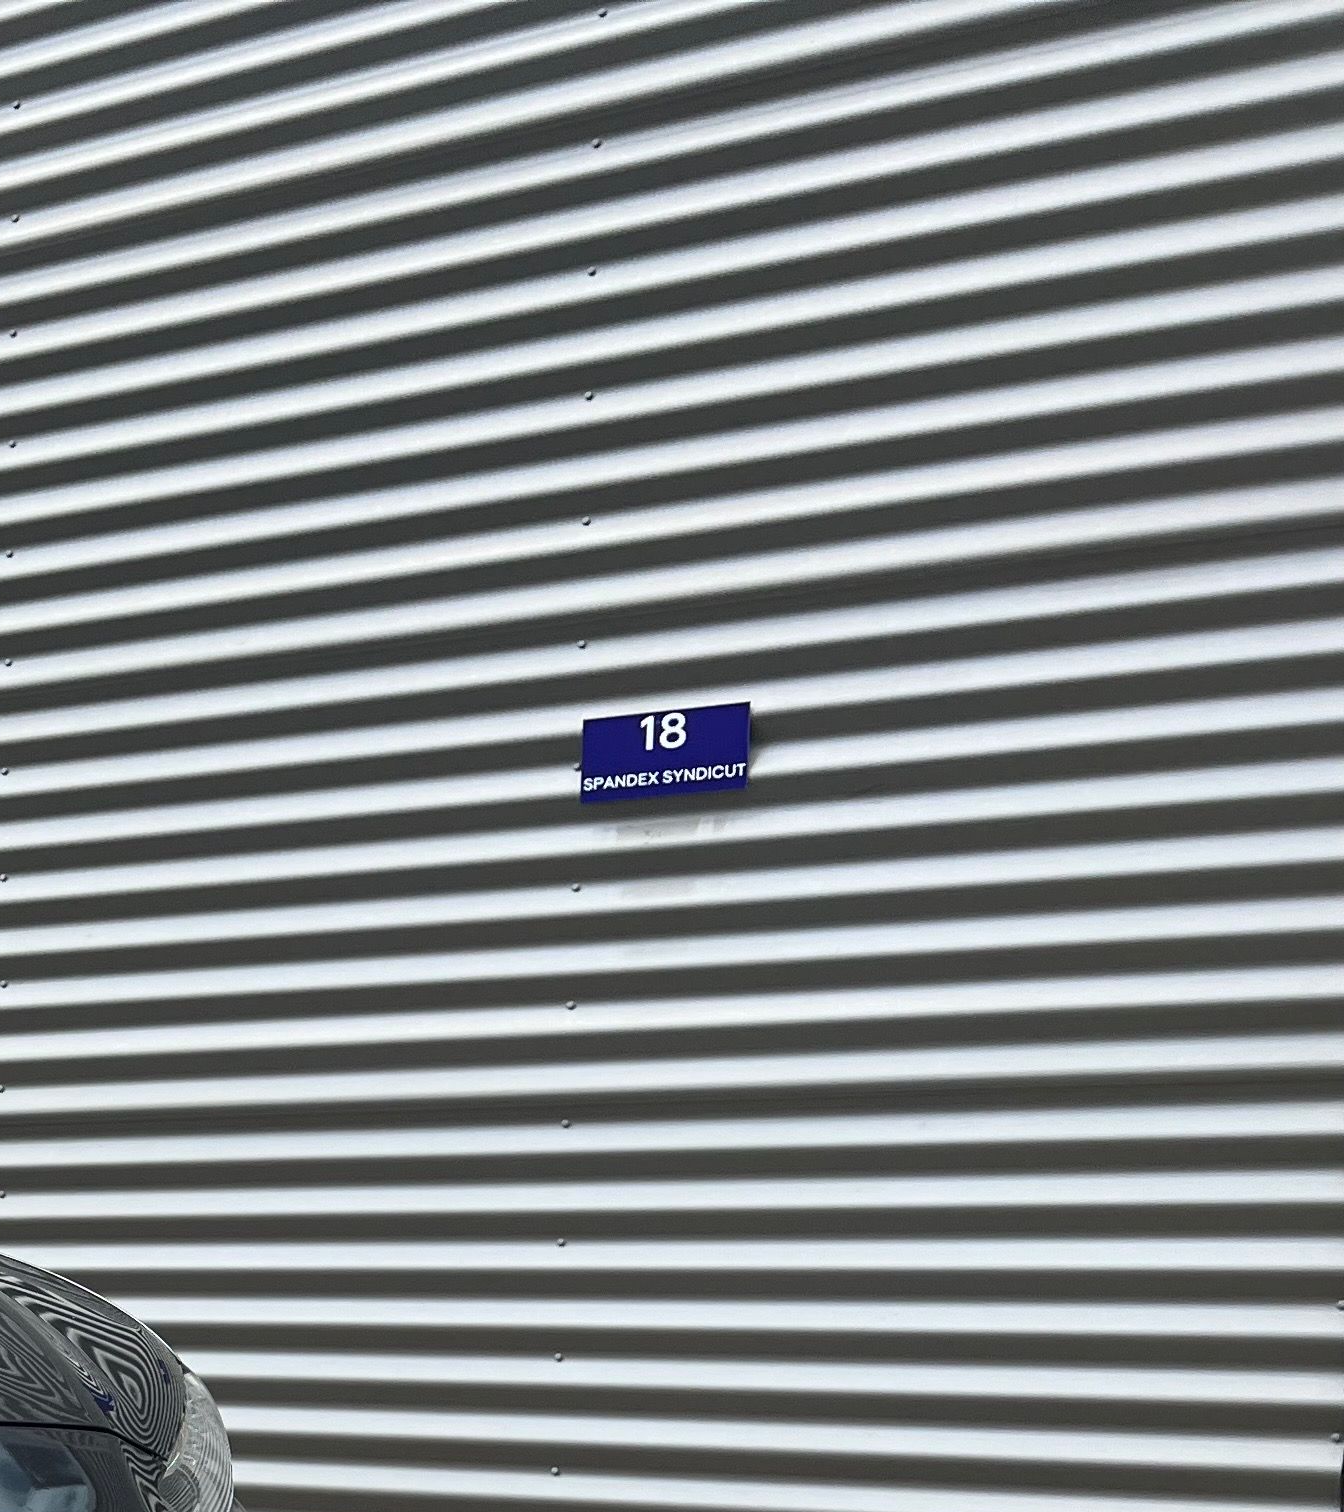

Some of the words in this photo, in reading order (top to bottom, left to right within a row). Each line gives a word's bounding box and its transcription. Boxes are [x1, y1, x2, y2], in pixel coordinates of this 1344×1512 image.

[640, 712, 687, 751] 18
[583, 771, 659, 792] SPANDEX
[662, 762, 747, 785] SYNDICUT
